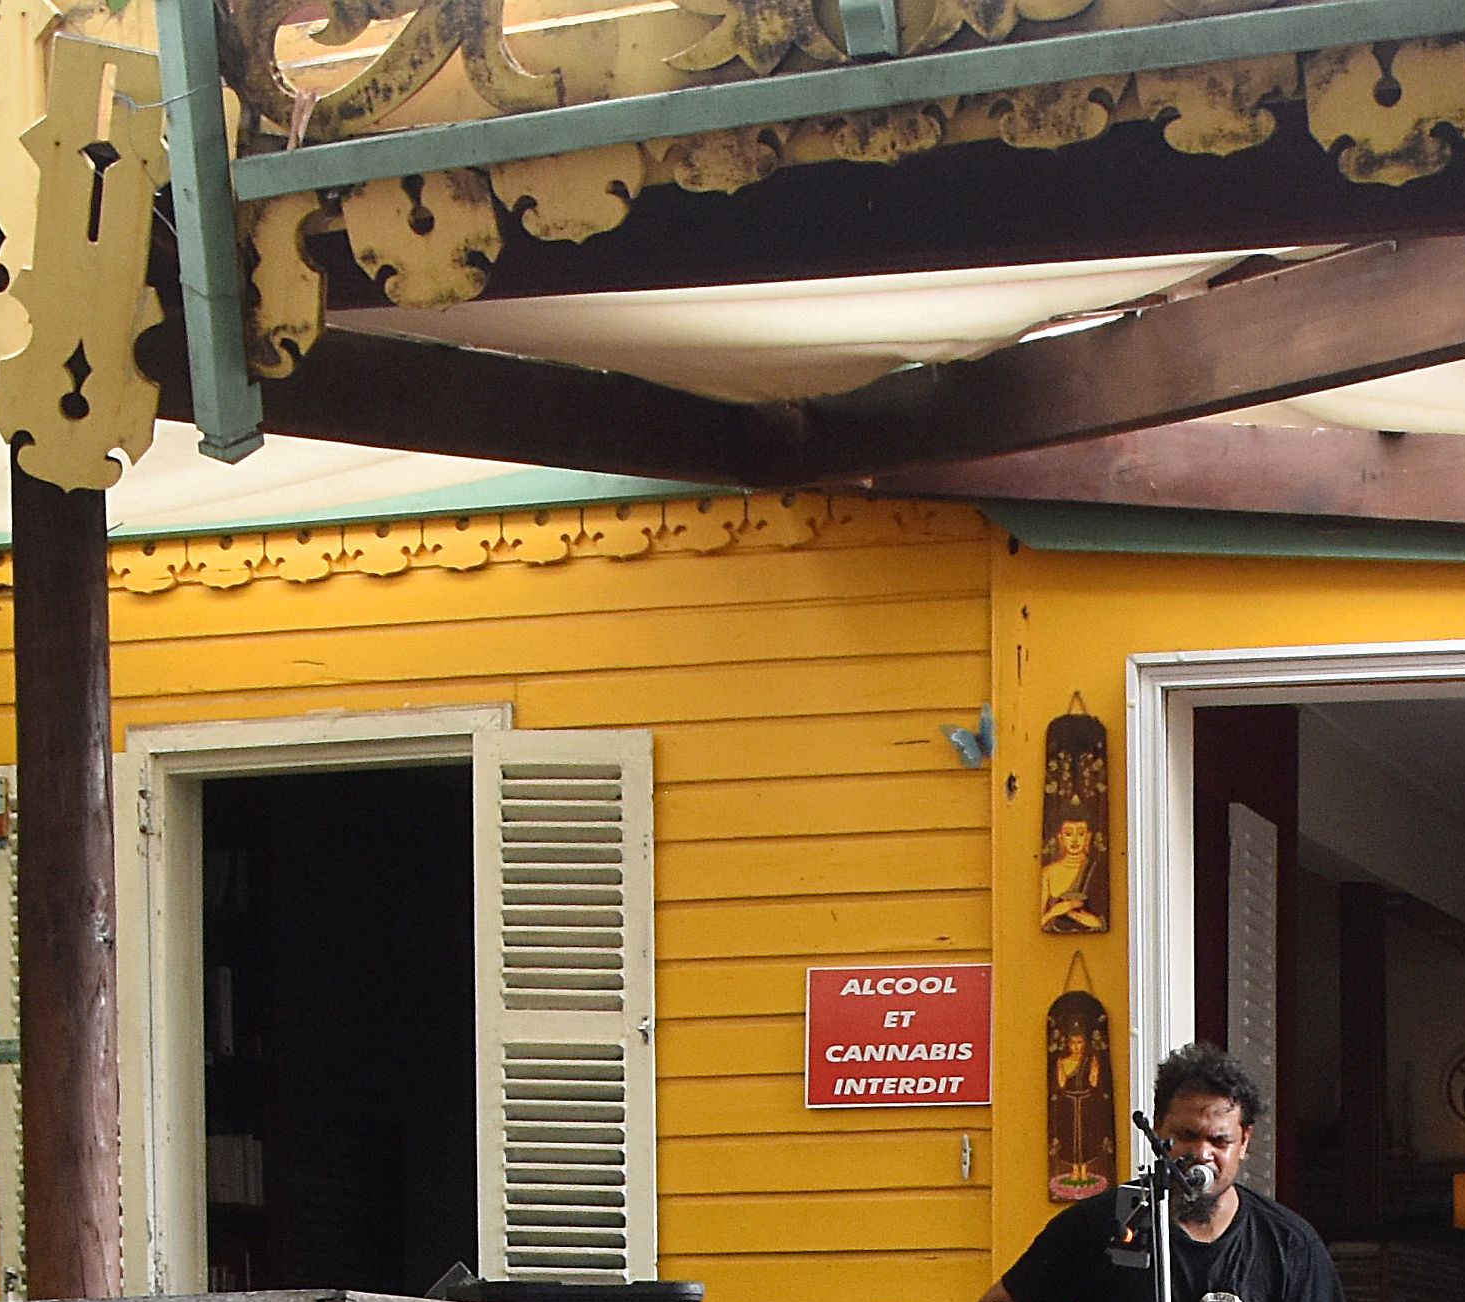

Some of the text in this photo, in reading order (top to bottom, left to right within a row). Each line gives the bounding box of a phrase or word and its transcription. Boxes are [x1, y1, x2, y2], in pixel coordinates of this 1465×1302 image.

[840, 976, 958, 996] ALCOOL
[883, 1010, 916, 1028] ET
[825, 1043, 973, 1062] CANNABIS
[833, 1076, 965, 1095] INTERDIT
